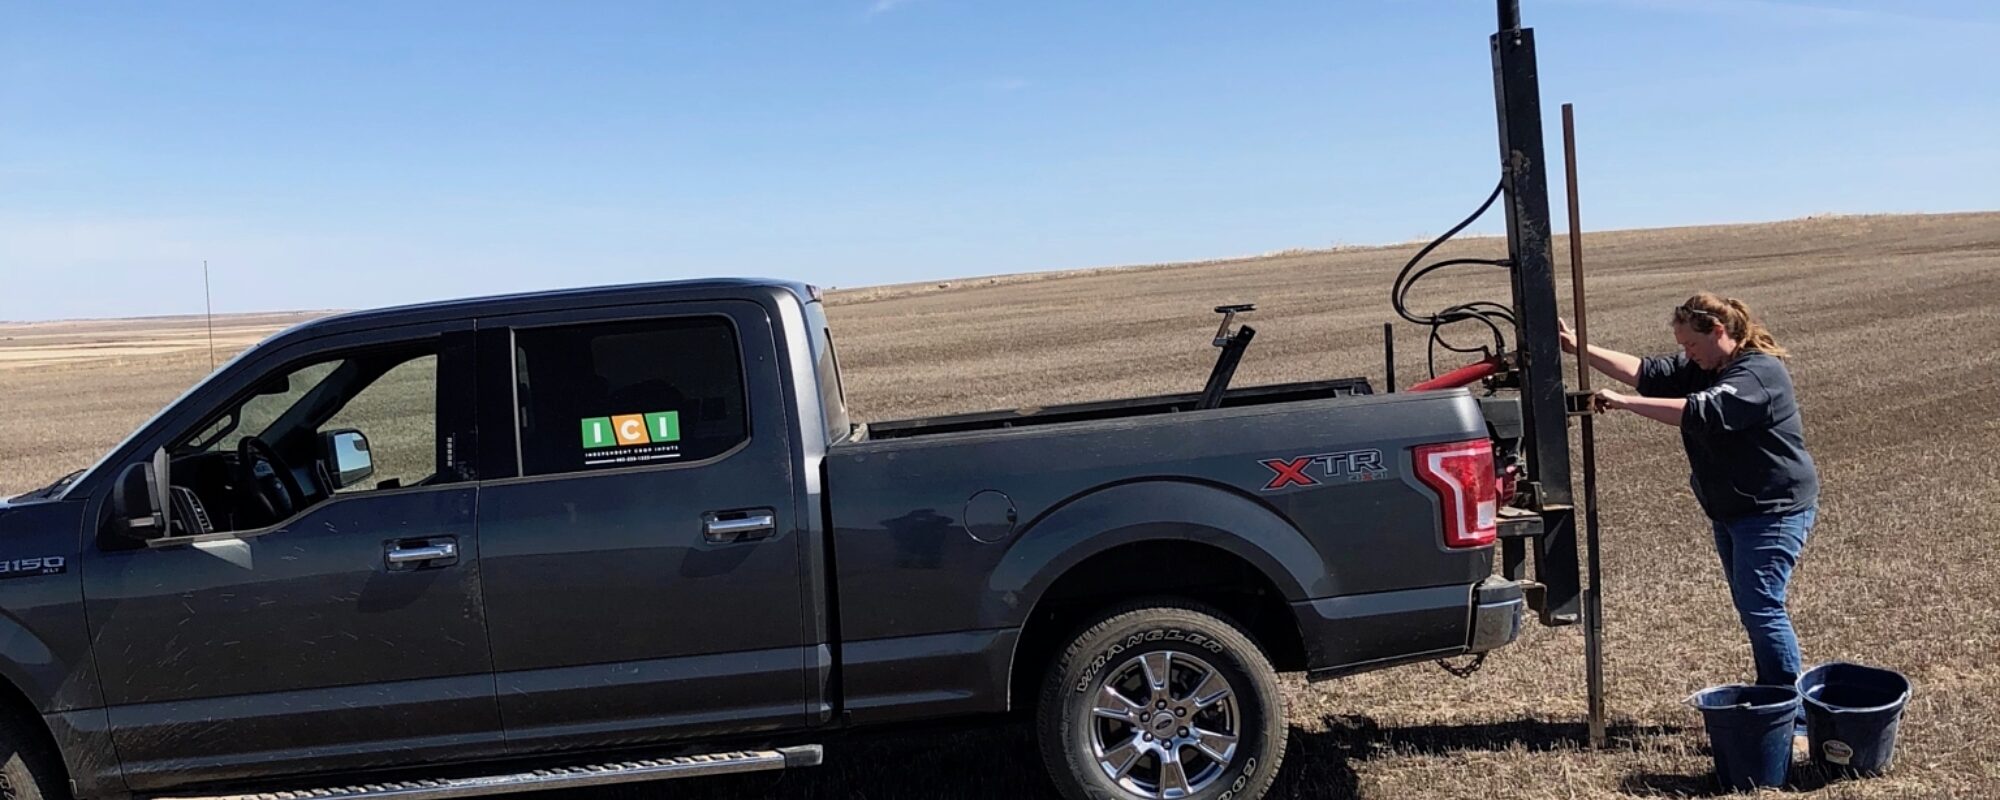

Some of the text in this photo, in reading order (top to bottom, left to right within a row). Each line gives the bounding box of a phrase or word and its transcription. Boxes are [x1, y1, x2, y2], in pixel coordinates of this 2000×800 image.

[593, 416, 668, 443] ICI
[585, 449, 632, 458] INDEPENDENT
[1257, 448, 1388, 491] XTR
[1076, 629, 1224, 693] WRANGLER
